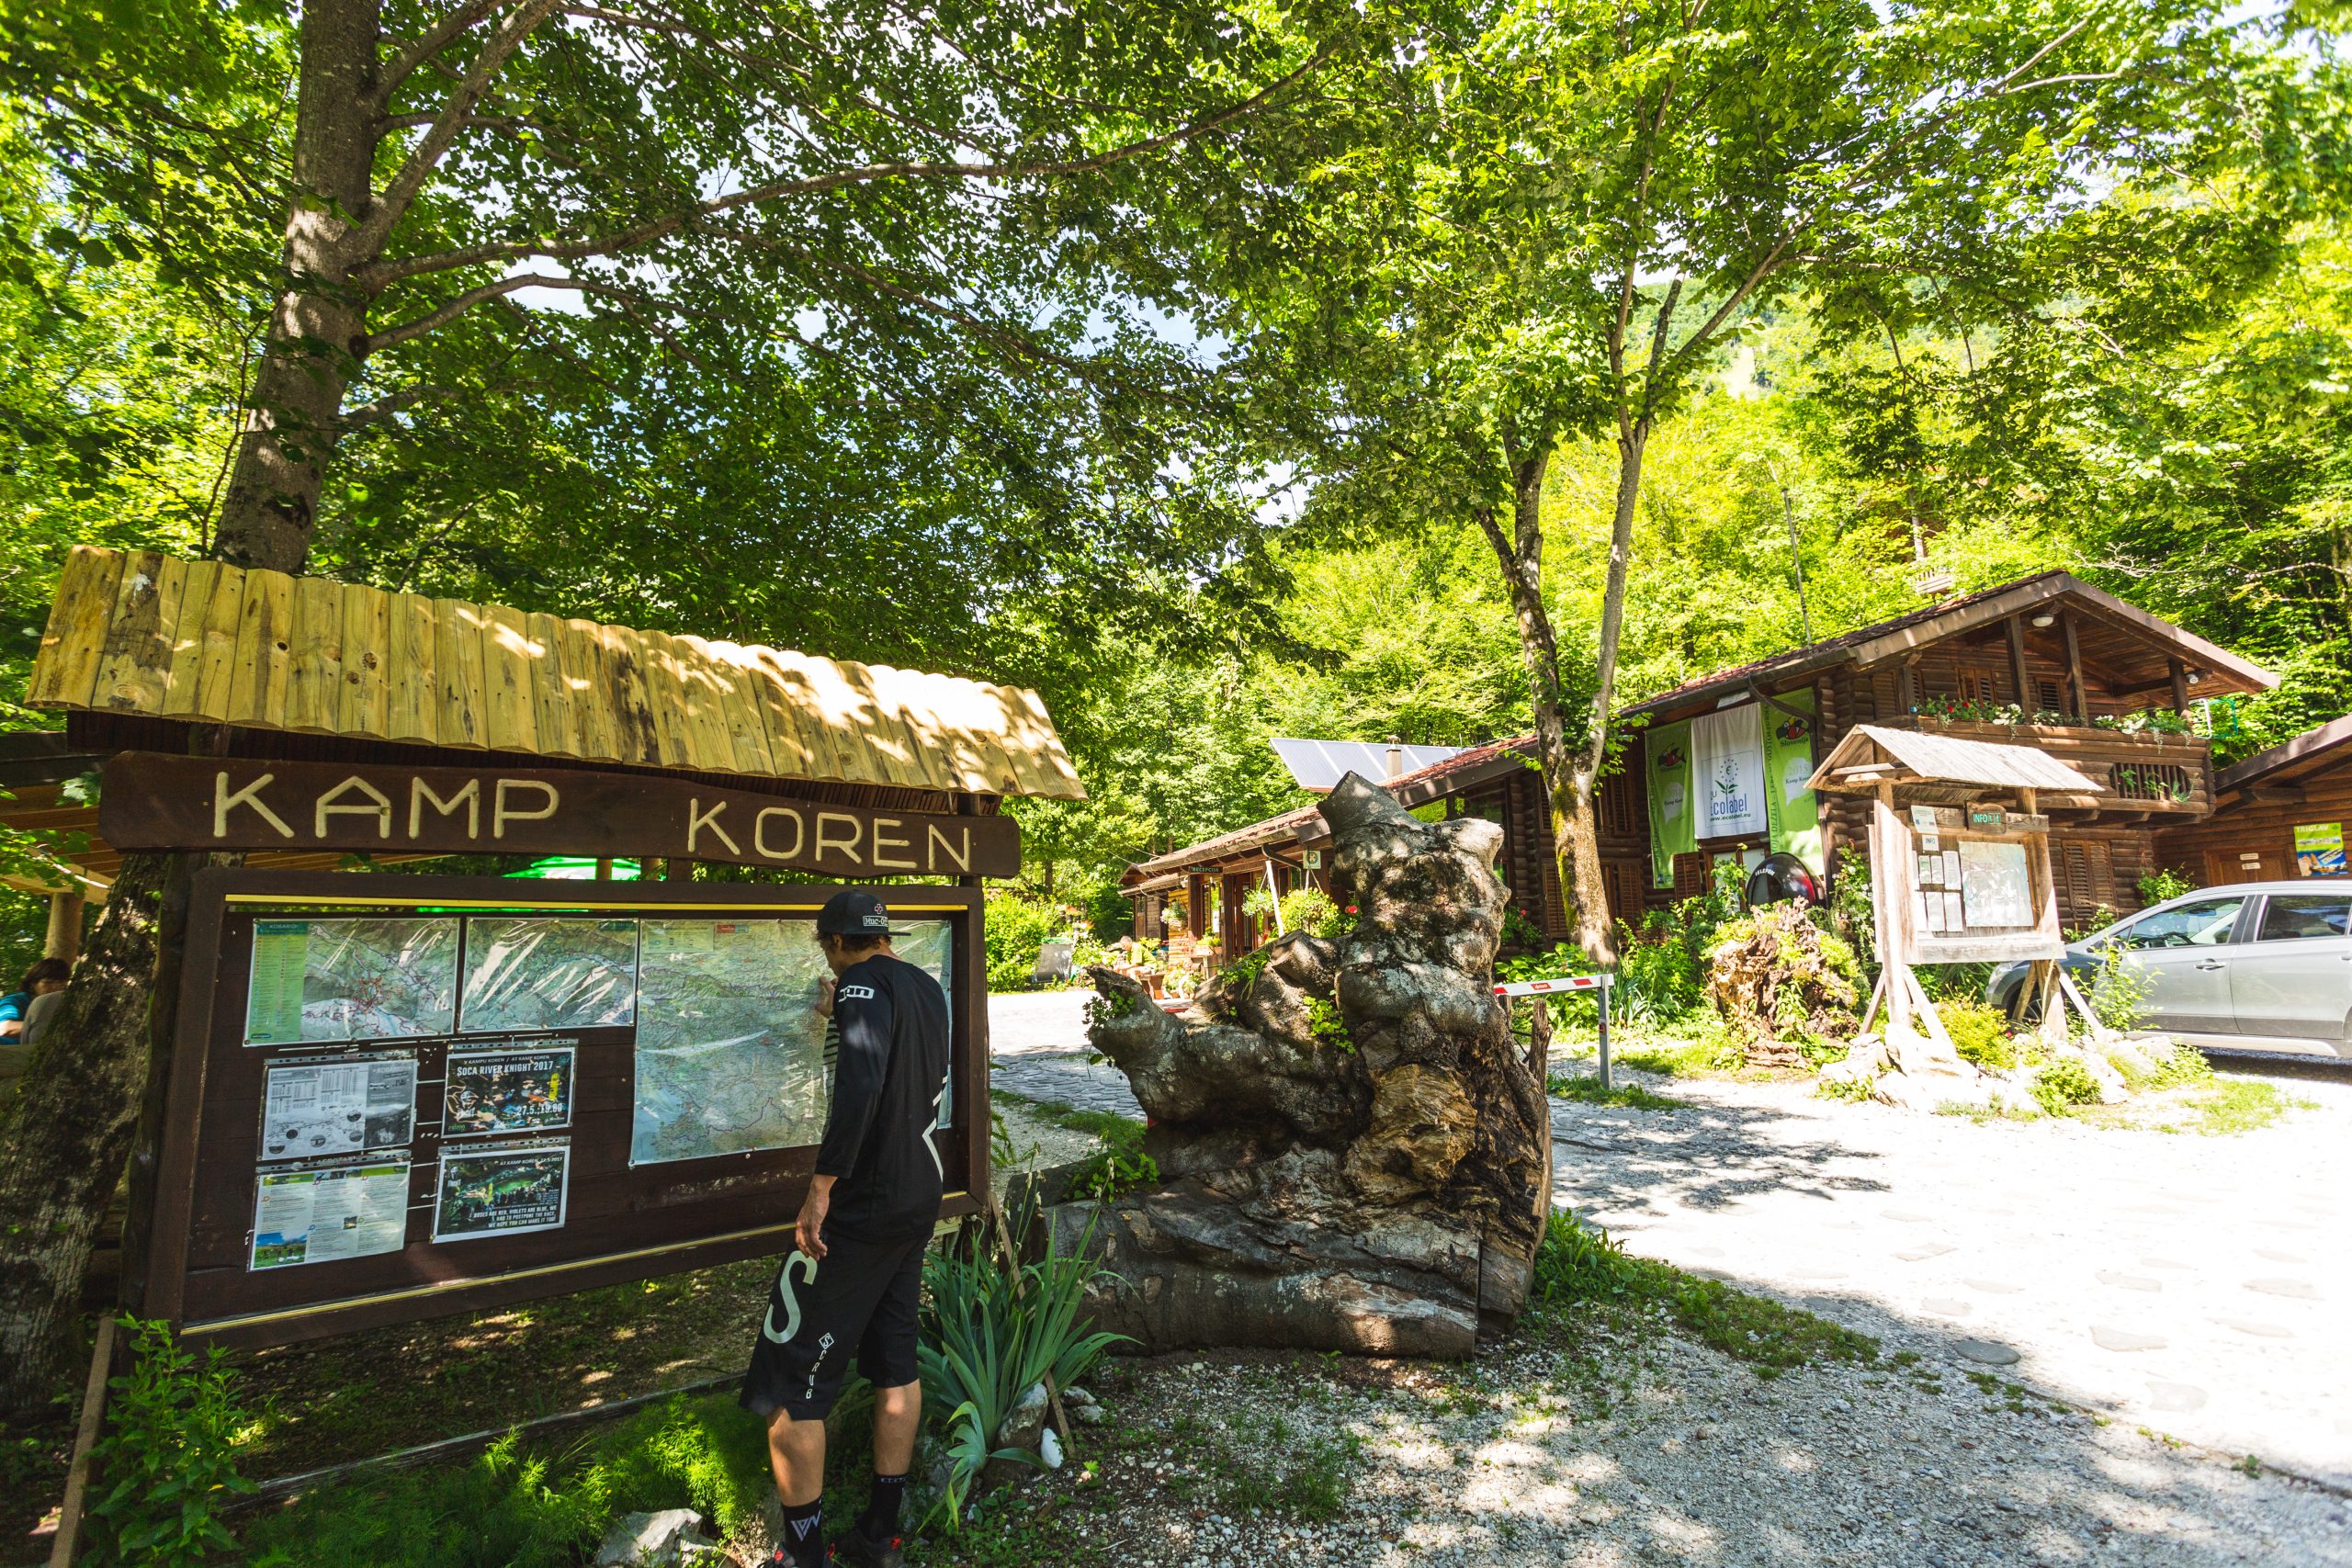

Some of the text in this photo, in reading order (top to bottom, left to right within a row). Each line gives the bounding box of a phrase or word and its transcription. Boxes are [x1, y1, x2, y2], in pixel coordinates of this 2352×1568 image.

[1780, 737, 1809, 748] Slovenija
[213, 772, 971, 873] KAMP KOREN
[1973, 813, 1988, 823] INFO
[2297, 824, 2329, 833] TRIGLAV
[1755, 868, 1776, 876] TELEFON
[457, 1061, 554, 1077] SOCA RIVER KNIGHT 2017
[763, 1250, 818, 1344] S
